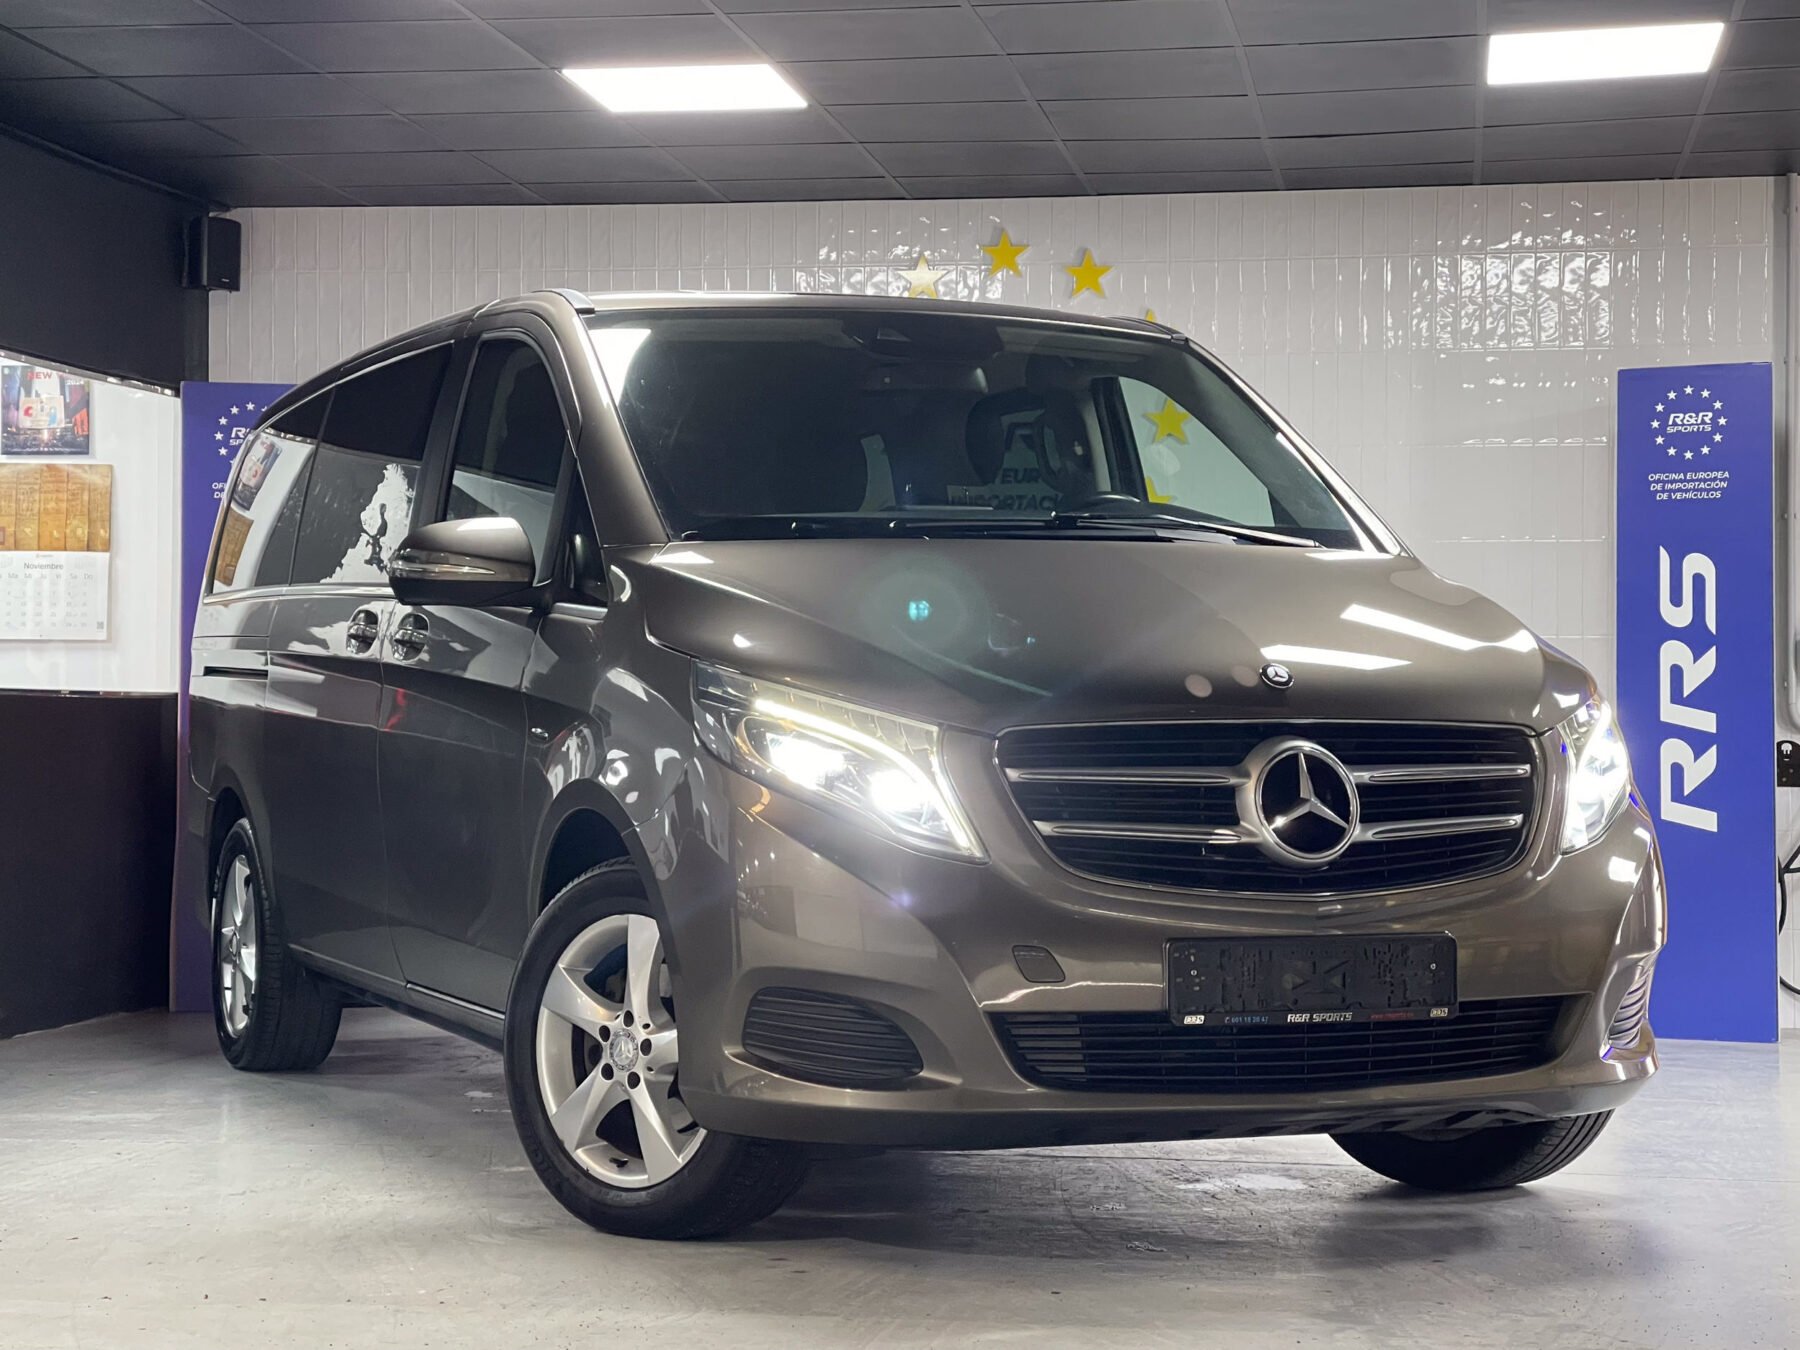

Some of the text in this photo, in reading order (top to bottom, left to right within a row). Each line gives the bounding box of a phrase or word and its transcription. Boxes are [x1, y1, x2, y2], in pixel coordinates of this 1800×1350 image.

[1668, 412, 1713, 425] R&R
[1666, 424, 1712, 433] SPORTS
[1648, 471, 1729, 481] OFICINA EUROPEA
[1650, 480, 1728, 491] DE IMPORTACIÓN
[1656, 490, 1722, 500] DE VEHÍCULOS
[24, 562, 64, 571] Noviembre
[1659, 545, 1718, 833] RRS
[1287, 1012, 1310, 1023] R&R
[1312, 1012, 1353, 1022] SPORTS
